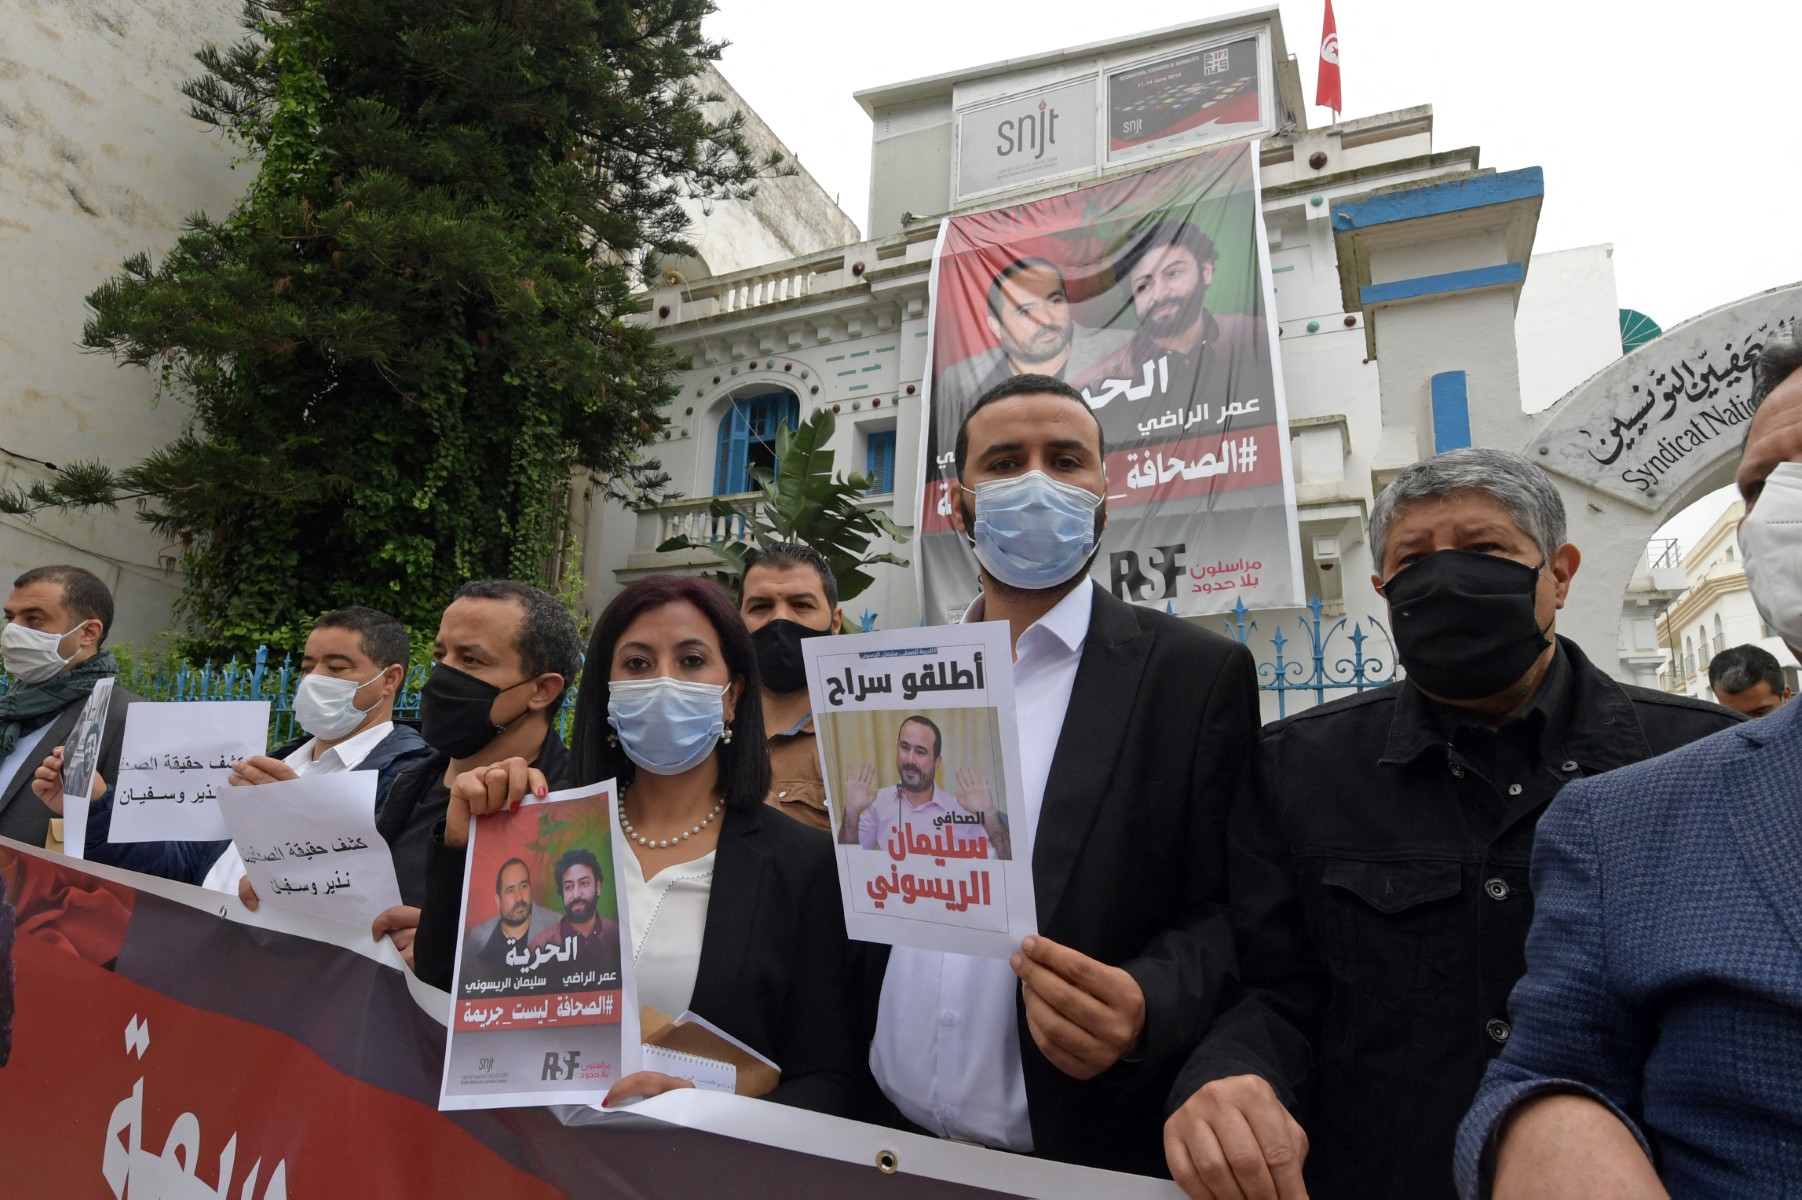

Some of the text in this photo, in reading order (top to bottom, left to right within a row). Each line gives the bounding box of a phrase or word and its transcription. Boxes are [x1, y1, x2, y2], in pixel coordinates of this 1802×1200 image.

[996, 100, 1059, 159] snjt
[1123, 118, 1142, 134] snjt
[1137, 398, 1260, 436] عمر الراضي
[1621, 418, 1712, 492] Syndicat
[1109, 543, 1187, 602] RSF
[1189, 558, 1262, 580] مراسلون
[1191, 573, 1259, 595] بلا حدود
[825, 652, 985, 706] أطلقو سراح
[163, 753, 204, 774] حقيقة
[119, 783, 221, 806] ذير وسفيان
[932, 811, 986, 831] الصحافي
[285, 841, 329, 861] حقيقة
[331, 837, 369, 852] كشف
[887, 822, 989, 867] سليمان
[323, 870, 351, 895] نذير
[866, 864, 991, 912] الريسوني
[505, 935, 578, 974] الحرية
[465, 975, 547, 993] سليمان الريسوني
[562, 970, 617, 986] عمر الراضي
[478, 1055, 495, 1073] snjt
[541, 1050, 581, 1081] RSF
